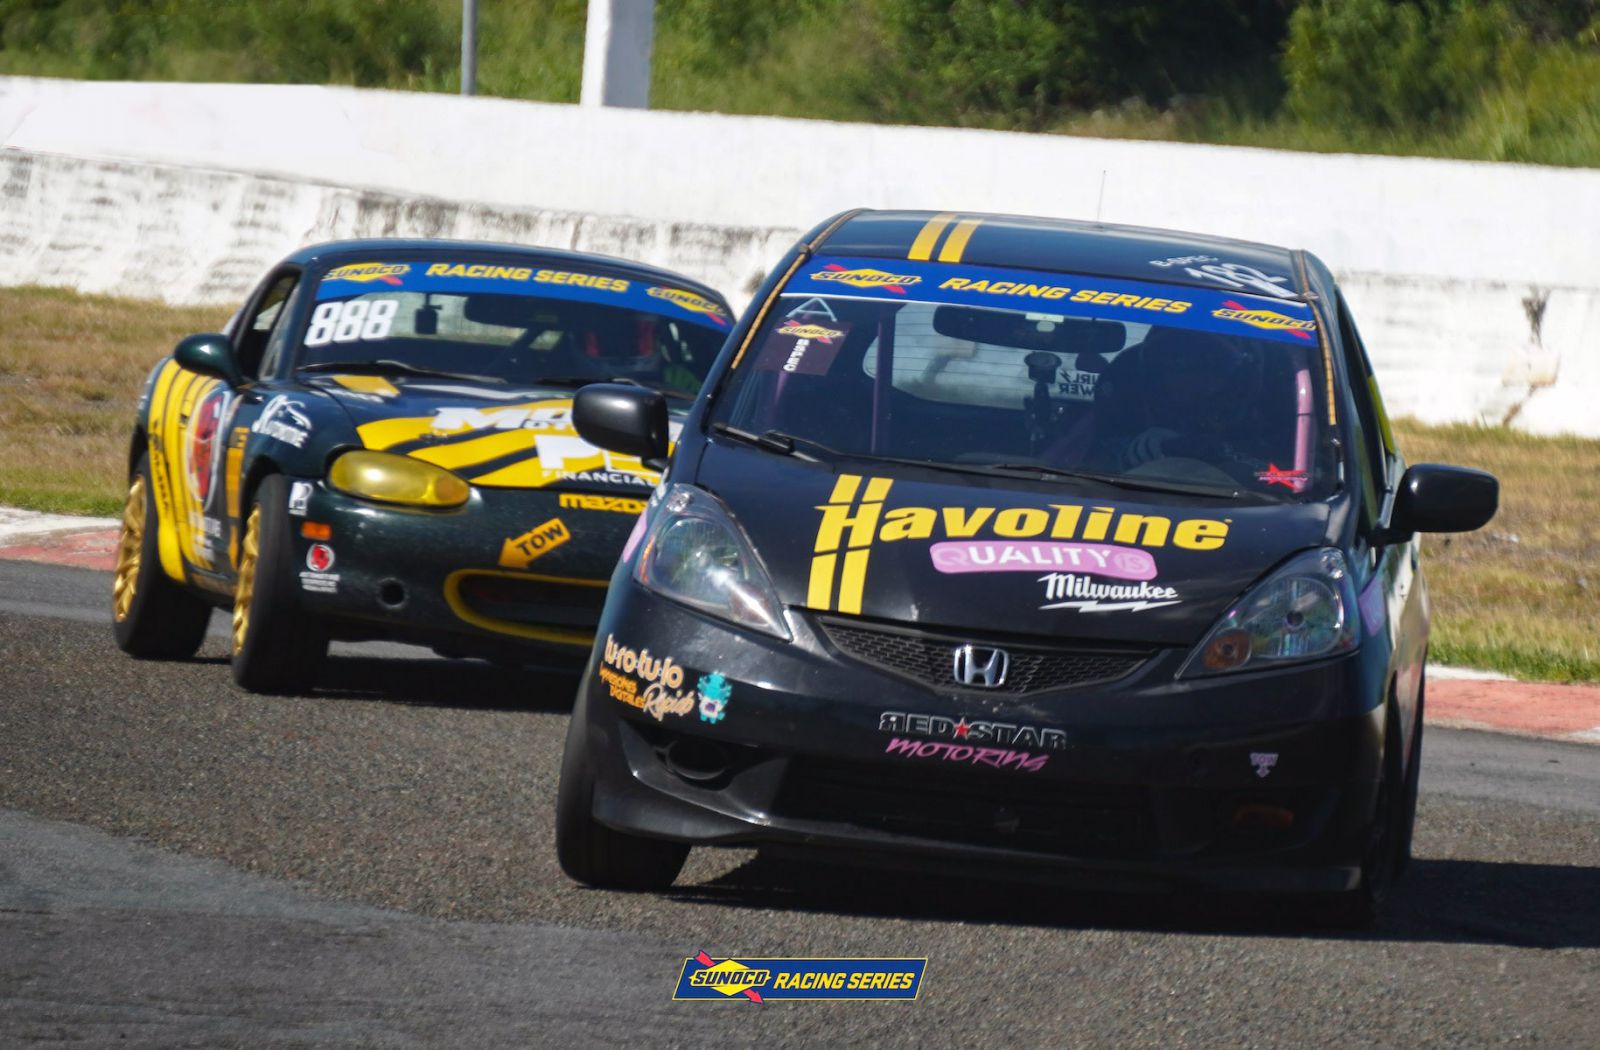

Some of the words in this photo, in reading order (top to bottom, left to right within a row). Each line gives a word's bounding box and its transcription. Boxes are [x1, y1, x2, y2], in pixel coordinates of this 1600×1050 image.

[425, 263, 532, 280] RACING
[533, 270, 630, 292] SERIES
[819, 271, 914, 285] SUNOCO
[939, 277, 1070, 299] RACING
[1070, 289, 1192, 313] SERIES
[1219, 310, 1316, 329] SUNOCO
[304, 300, 399, 347] 888
[559, 494, 649, 514] mazd
[514, 522, 564, 559] TOW
[813, 500, 1232, 554] Havoline
[935, 546, 1112, 568] QUALITY
[1037, 572, 1179, 600] Milwaukee
[967, 720, 1067, 749] STAR
[884, 737, 1050, 772] MOTORING
